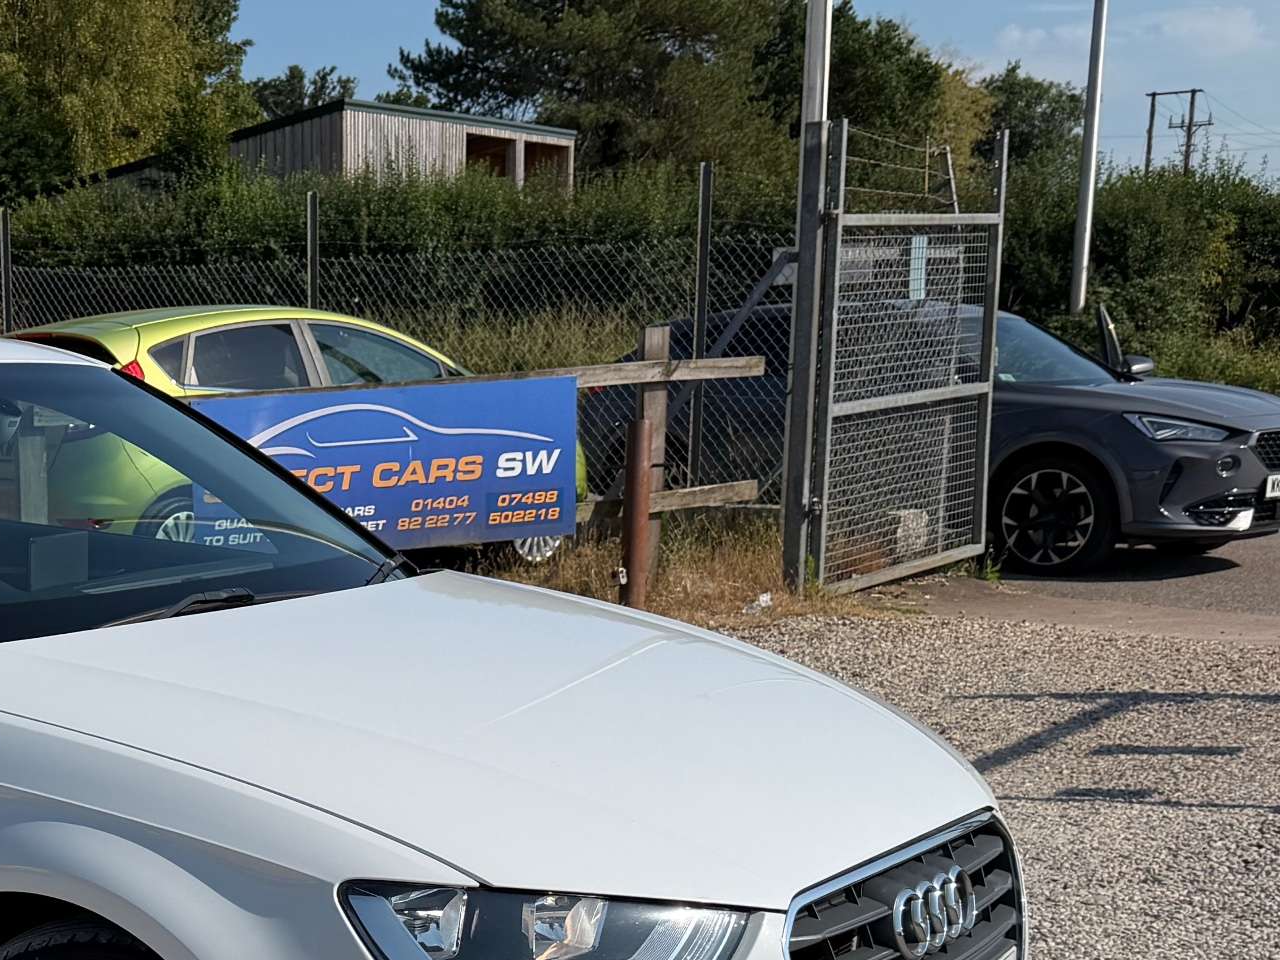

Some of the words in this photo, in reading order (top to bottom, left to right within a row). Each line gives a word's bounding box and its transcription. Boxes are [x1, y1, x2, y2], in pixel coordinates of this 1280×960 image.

[372, 455, 484, 488] CARS
[495, 448, 561, 478] SW
[411, 495, 470, 512] 01404
[497, 490, 558, 507] 07498
[340, 505, 375, 518] ARS
[488, 507, 560, 525] 502218
[203, 535, 224, 546] TO
[228, 532, 264, 545] SUIT
